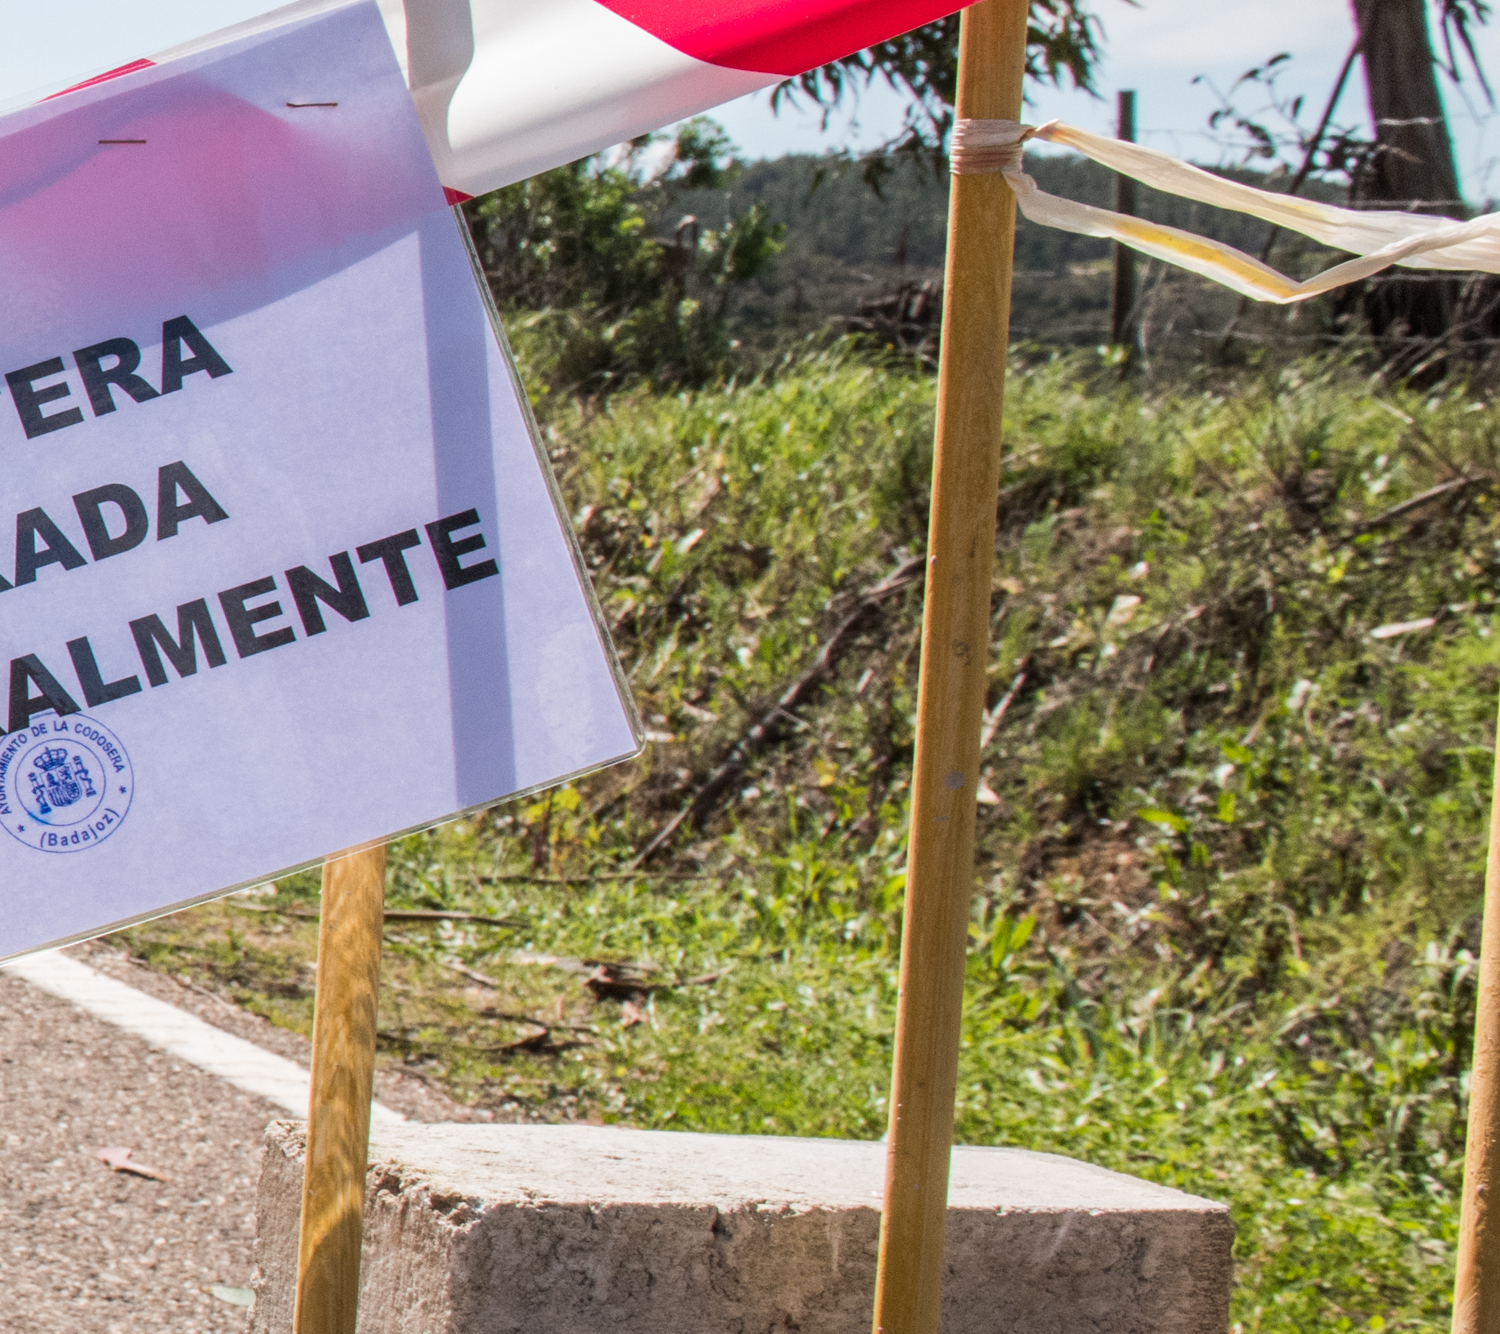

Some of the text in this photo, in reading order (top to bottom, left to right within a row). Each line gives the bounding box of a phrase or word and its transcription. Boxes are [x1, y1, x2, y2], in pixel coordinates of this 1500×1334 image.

[32, 723, 48, 737] DE
[54, 721, 68, 732] LA
[74, 723, 125, 773] CODOSERA
[40, 808, 120, 848] (Badajoz)
